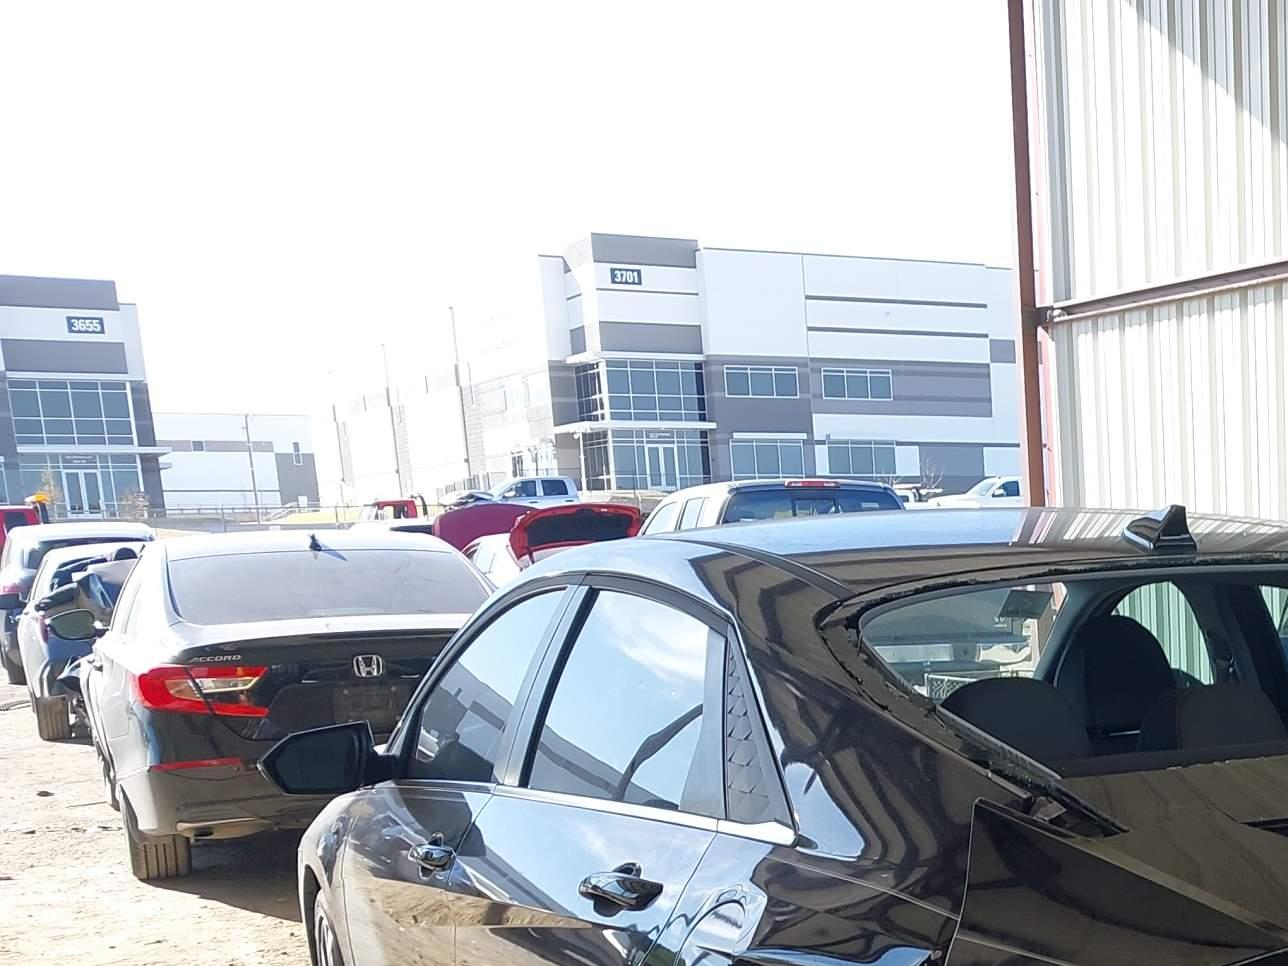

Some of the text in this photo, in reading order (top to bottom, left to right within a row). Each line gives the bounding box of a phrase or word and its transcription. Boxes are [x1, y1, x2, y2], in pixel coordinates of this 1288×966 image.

[614, 270, 639, 283] 3701
[71, 319, 101, 331] 3655
[189, 654, 242, 663] ACCORD
